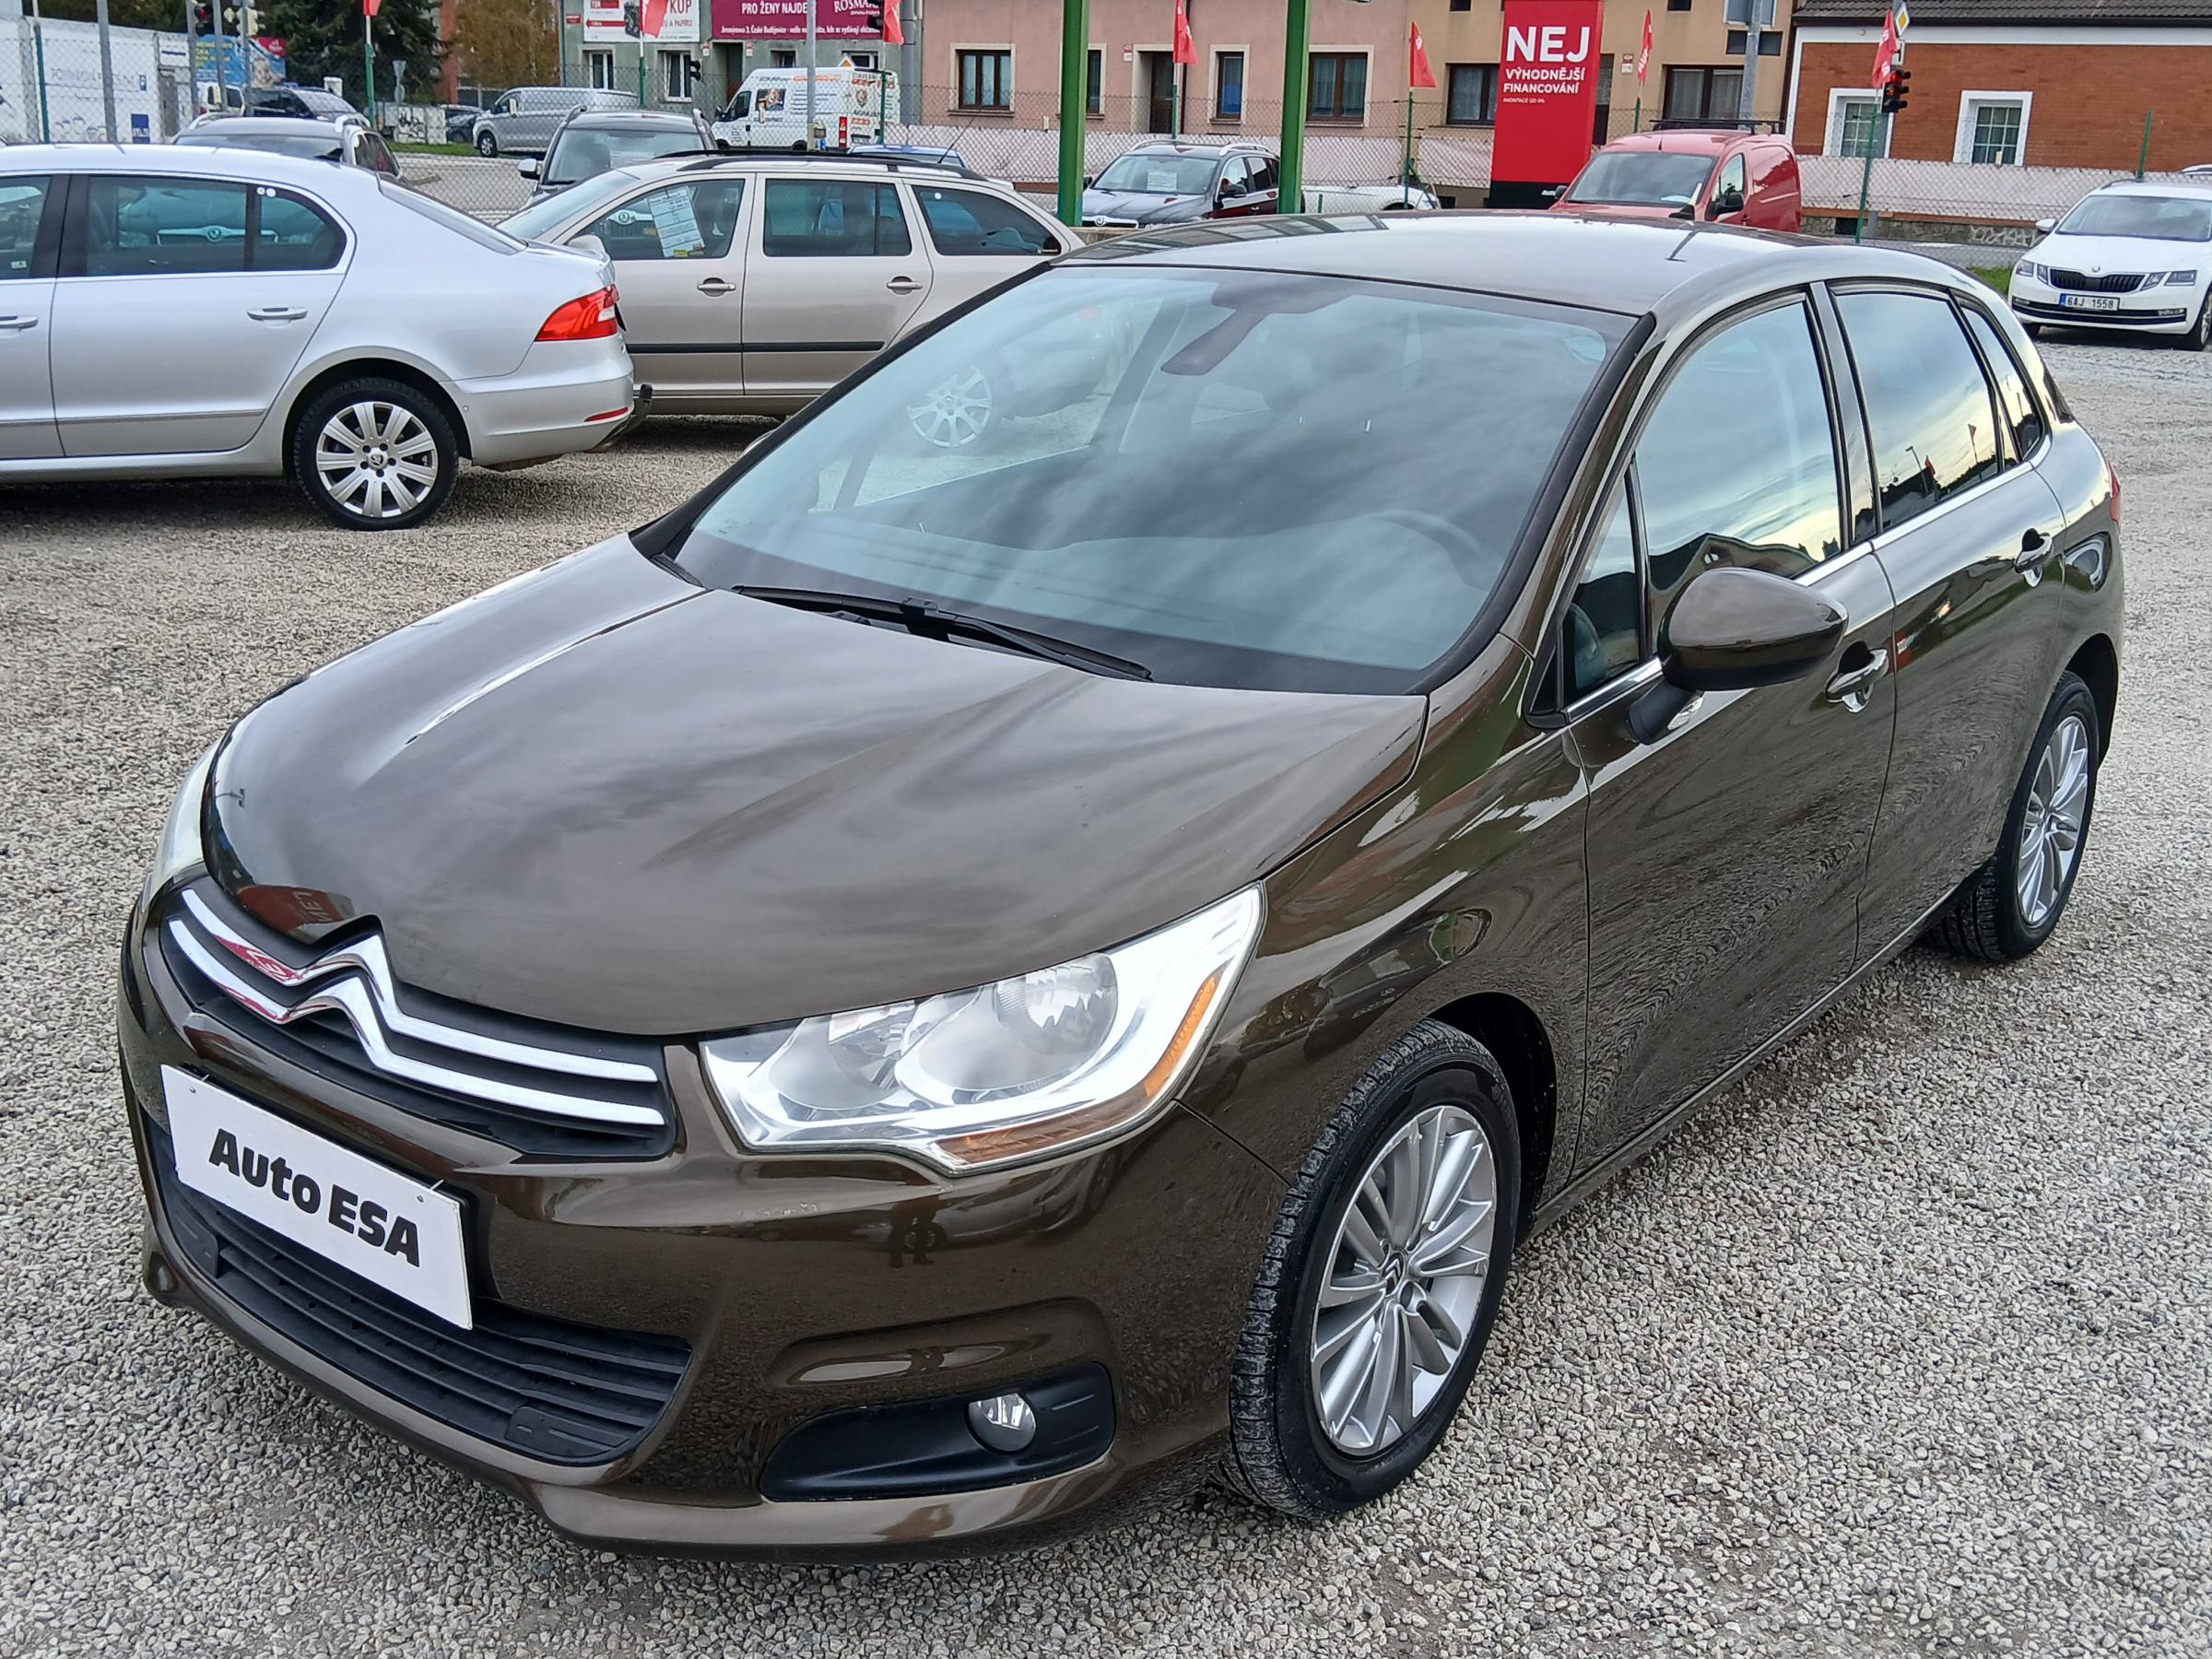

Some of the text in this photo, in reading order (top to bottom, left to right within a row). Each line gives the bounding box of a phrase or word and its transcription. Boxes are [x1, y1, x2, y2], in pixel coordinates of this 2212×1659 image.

[670, 0, 692, 14] KUP
[741, 0, 807, 15] PRO ŽENY NAJDE
[1505, 26, 1591, 63] NEJ
[1505, 66, 1586, 81] VÝHODNĚJŠÍ
[1503, 82, 1579, 94] FINANCOVÁNÍ
[2067, 297, 2114, 309] 6AJ 1558
[208, 1128, 421, 1268] Auto ESA
